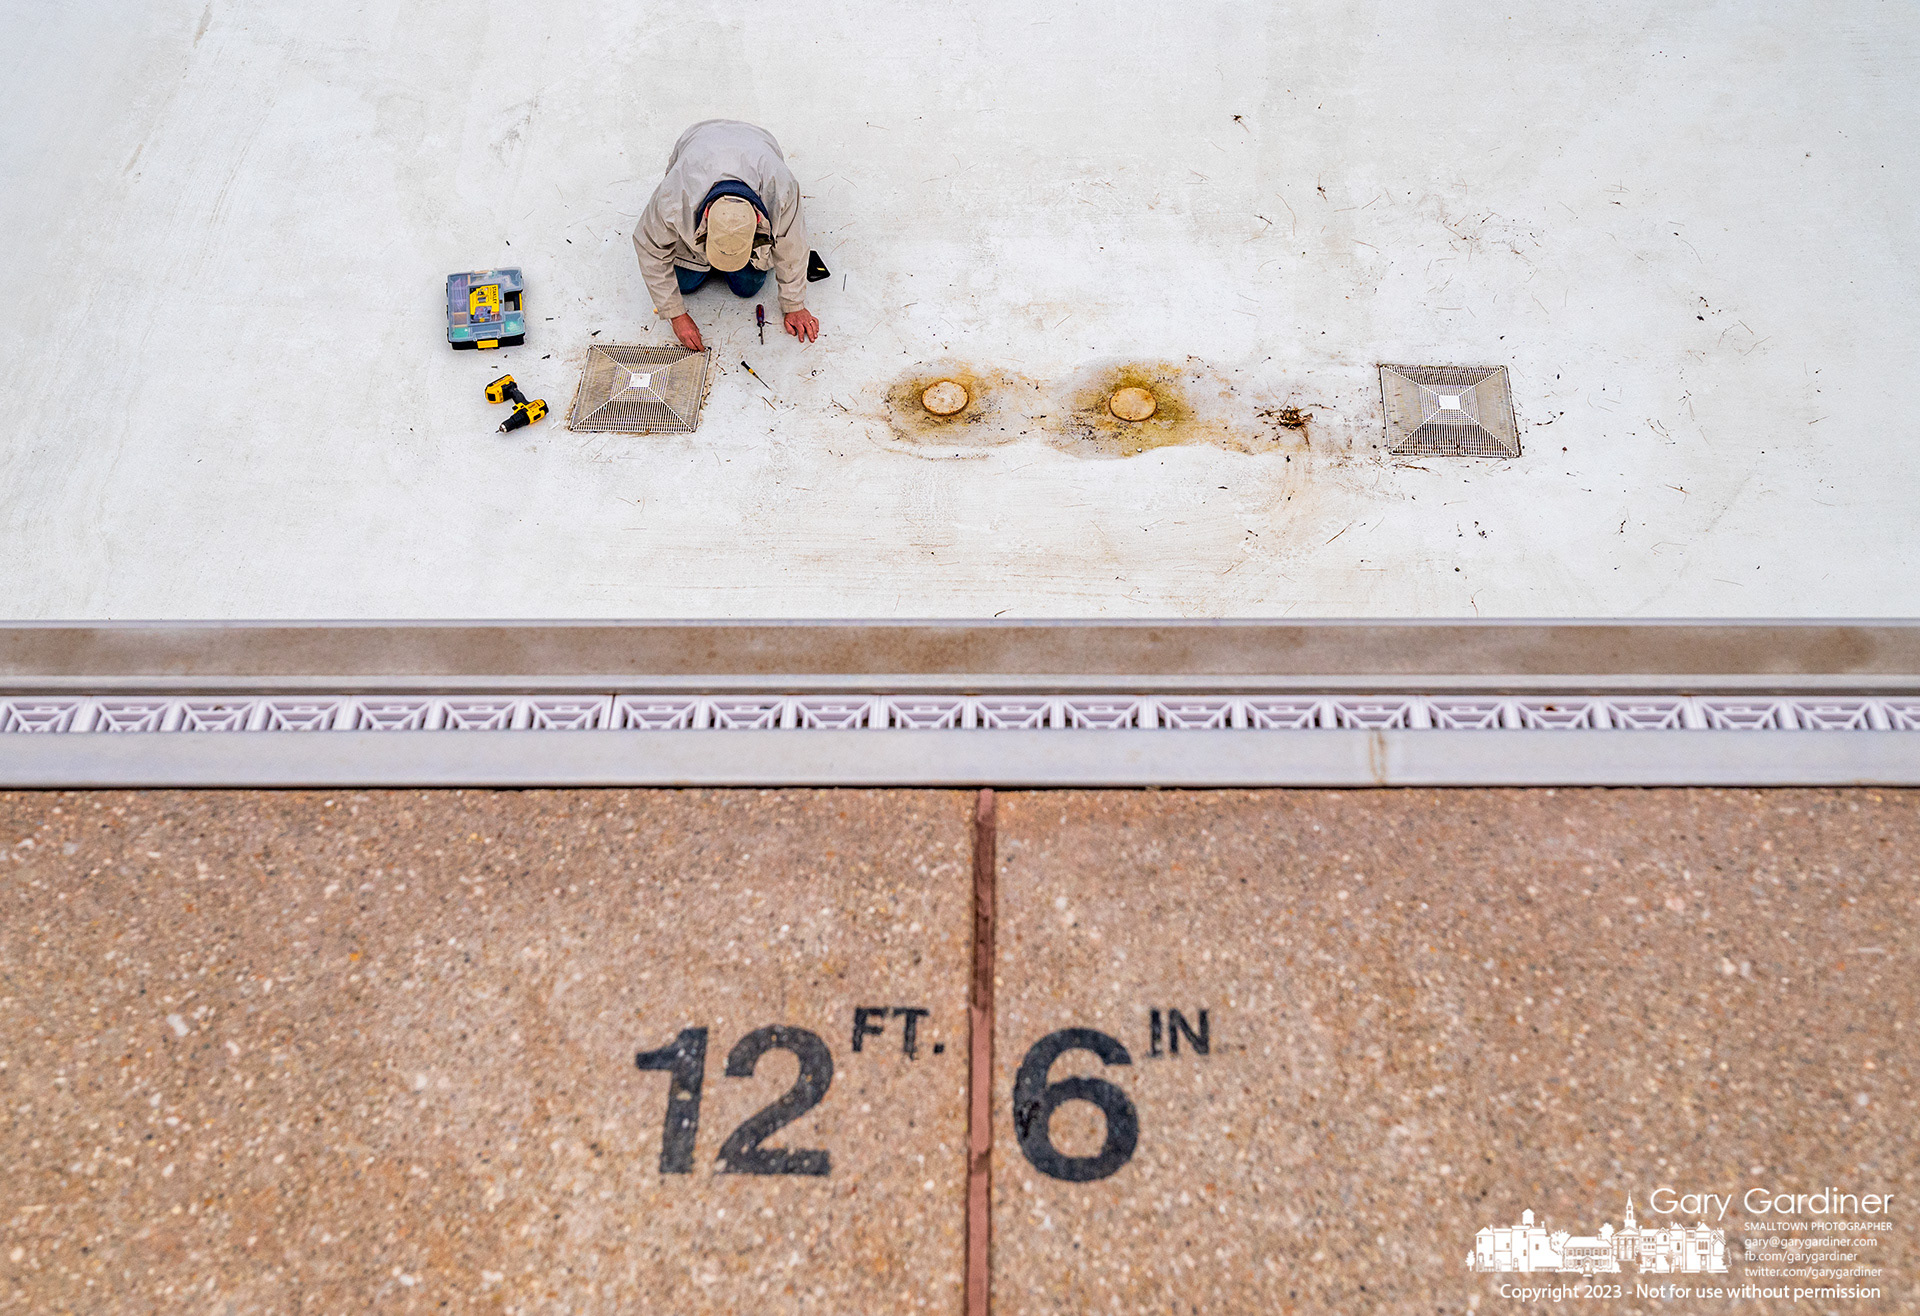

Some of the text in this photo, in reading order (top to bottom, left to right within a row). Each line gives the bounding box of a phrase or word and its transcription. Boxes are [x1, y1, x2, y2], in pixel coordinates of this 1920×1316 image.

[635, 1006, 1211, 1183] 12 FT. 6 IN
